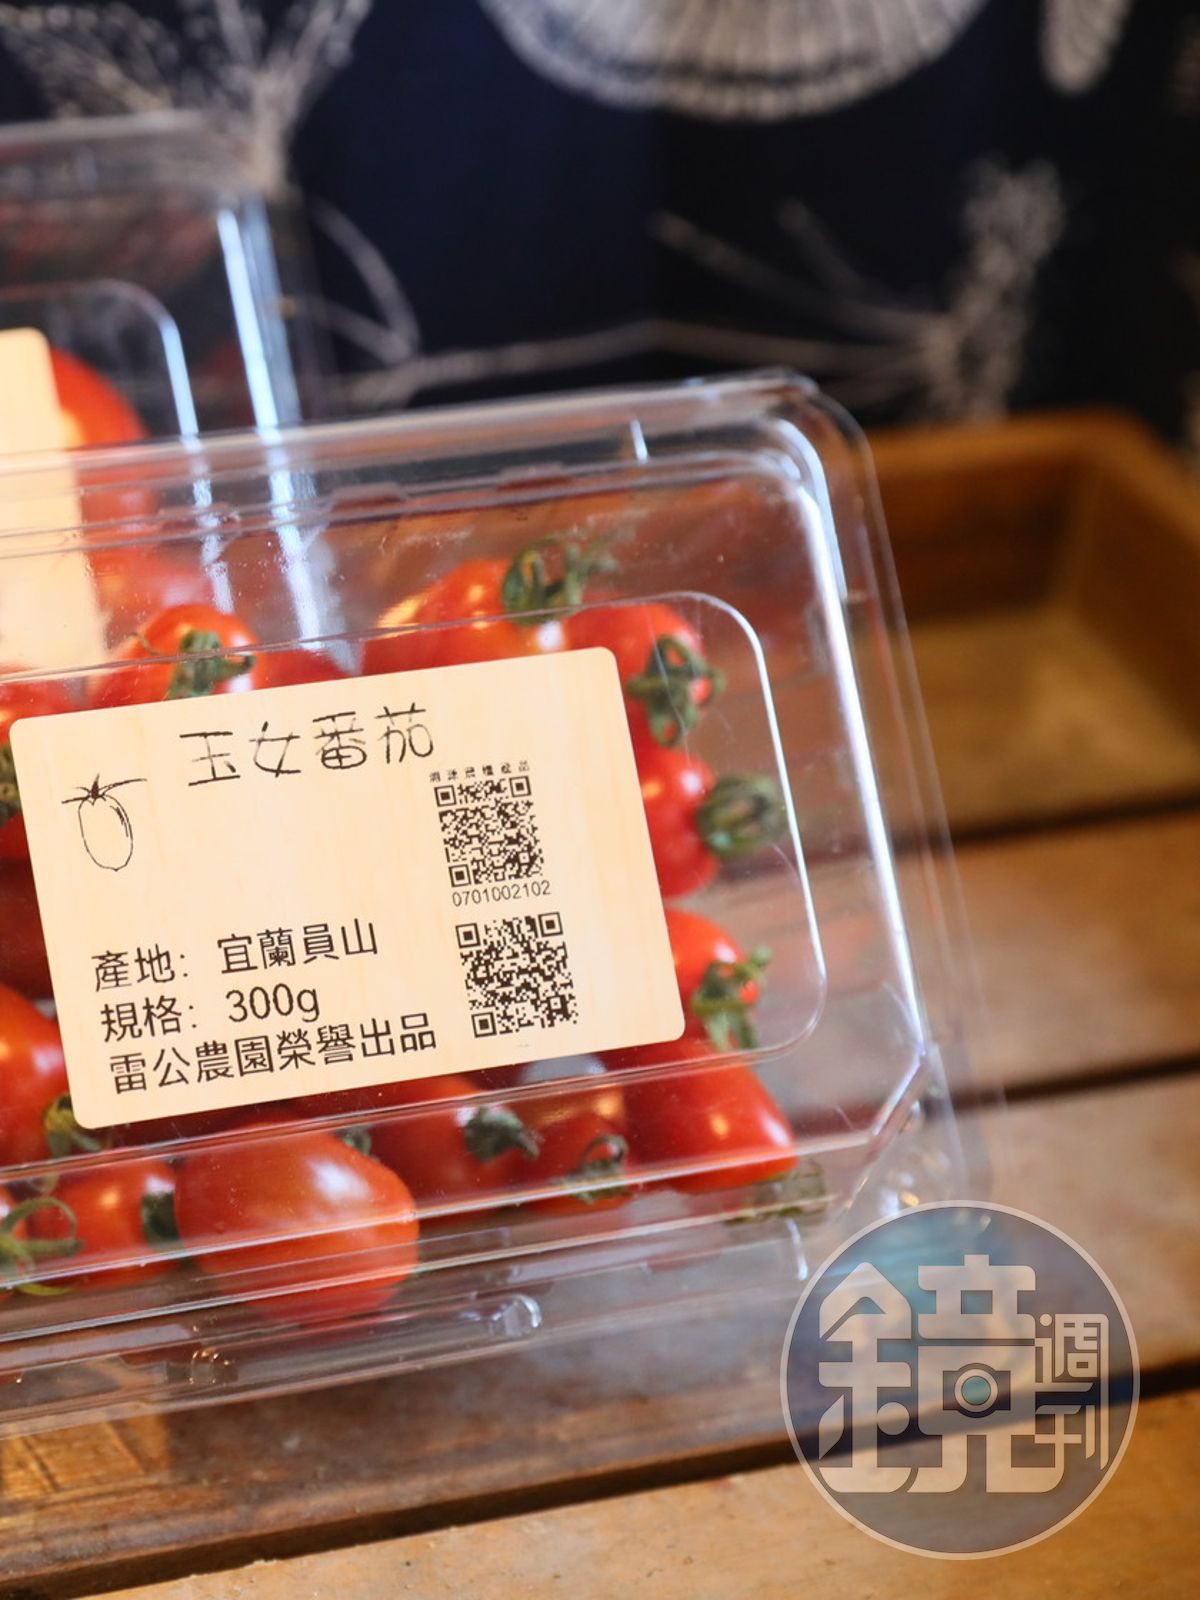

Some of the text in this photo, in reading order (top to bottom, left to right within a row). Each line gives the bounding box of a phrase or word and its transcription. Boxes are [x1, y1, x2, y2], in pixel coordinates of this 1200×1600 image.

[180, 702, 435, 787] 玉女番茄
[451, 879, 552, 908] 0701002102
[216, 918, 378, 974] 宜蘭員山
[225, 983, 321, 1023] 300g
[109, 1012, 437, 1095] 雷公農園榮譽出品
